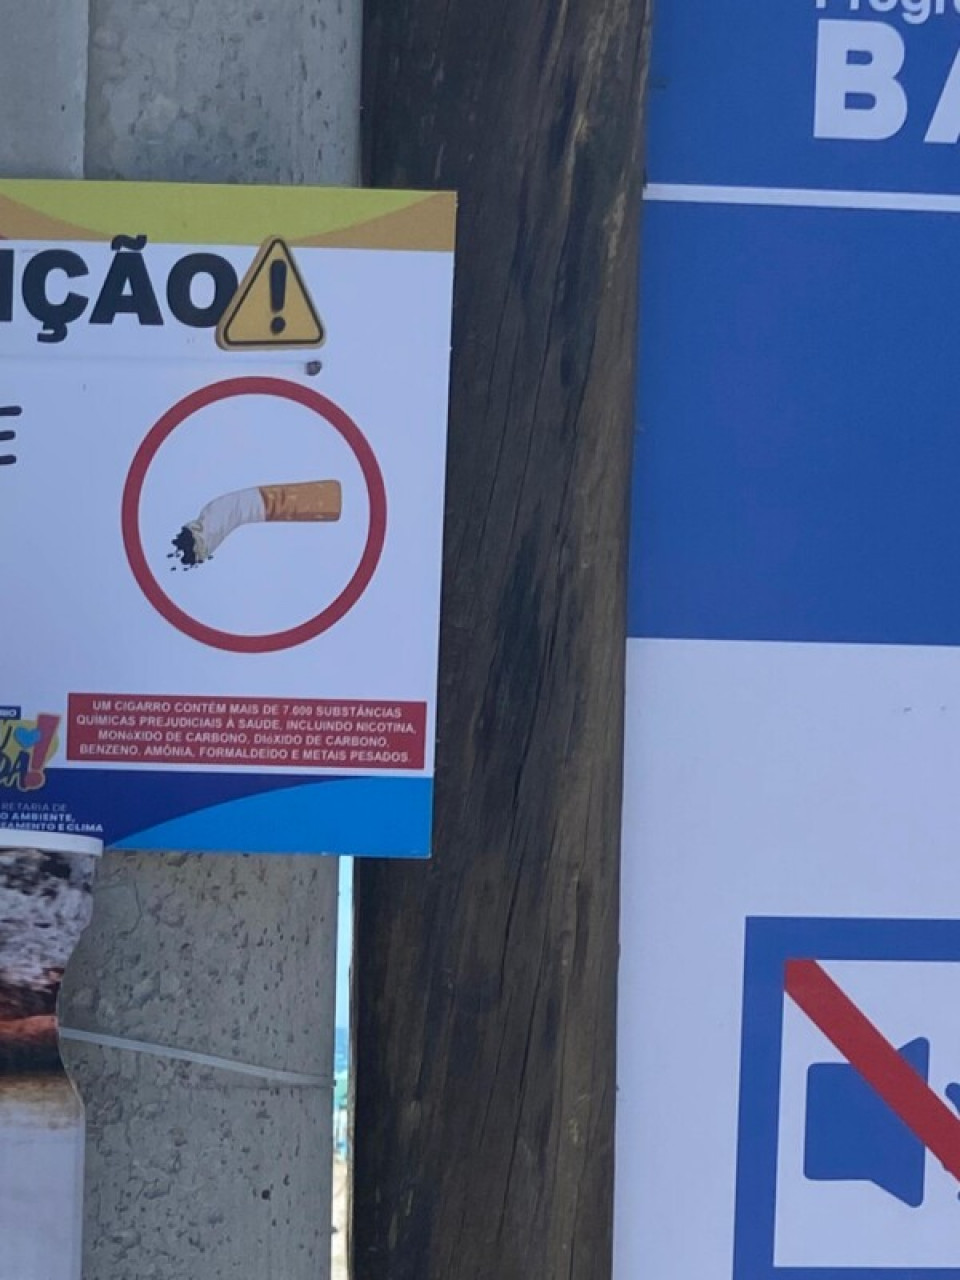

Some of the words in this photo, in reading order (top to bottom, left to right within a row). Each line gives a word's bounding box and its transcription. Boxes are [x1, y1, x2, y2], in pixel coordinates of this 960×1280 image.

[92, 700, 111, 711] UM
[114, 701, 171, 712] CIGARRO
[174, 702, 227, 714] CONTÉM
[229, 704, 259, 714] MAIS
[263, 704, 280, 715] DE
[316, 705, 402, 718] SUBSTÂNCIAS
[76, 713, 136, 726] QUÍMICAS
[139, 716, 223, 729] PREJUDICIAIS
[286, 720, 353, 732] INCLUINDO
[356, 722, 417, 735] NICOTINA,
[166, 731, 182, 743] DE
[305, 735, 322, 746] DE
[291, 749, 301, 760] E
[303, 748, 347, 761] METAIS
[52, 804, 67, 812] DE
[10, 813, 76, 824] AMBIENTE,
[57, 824, 65, 832] E
[66, 824, 103, 833] CLIMA
